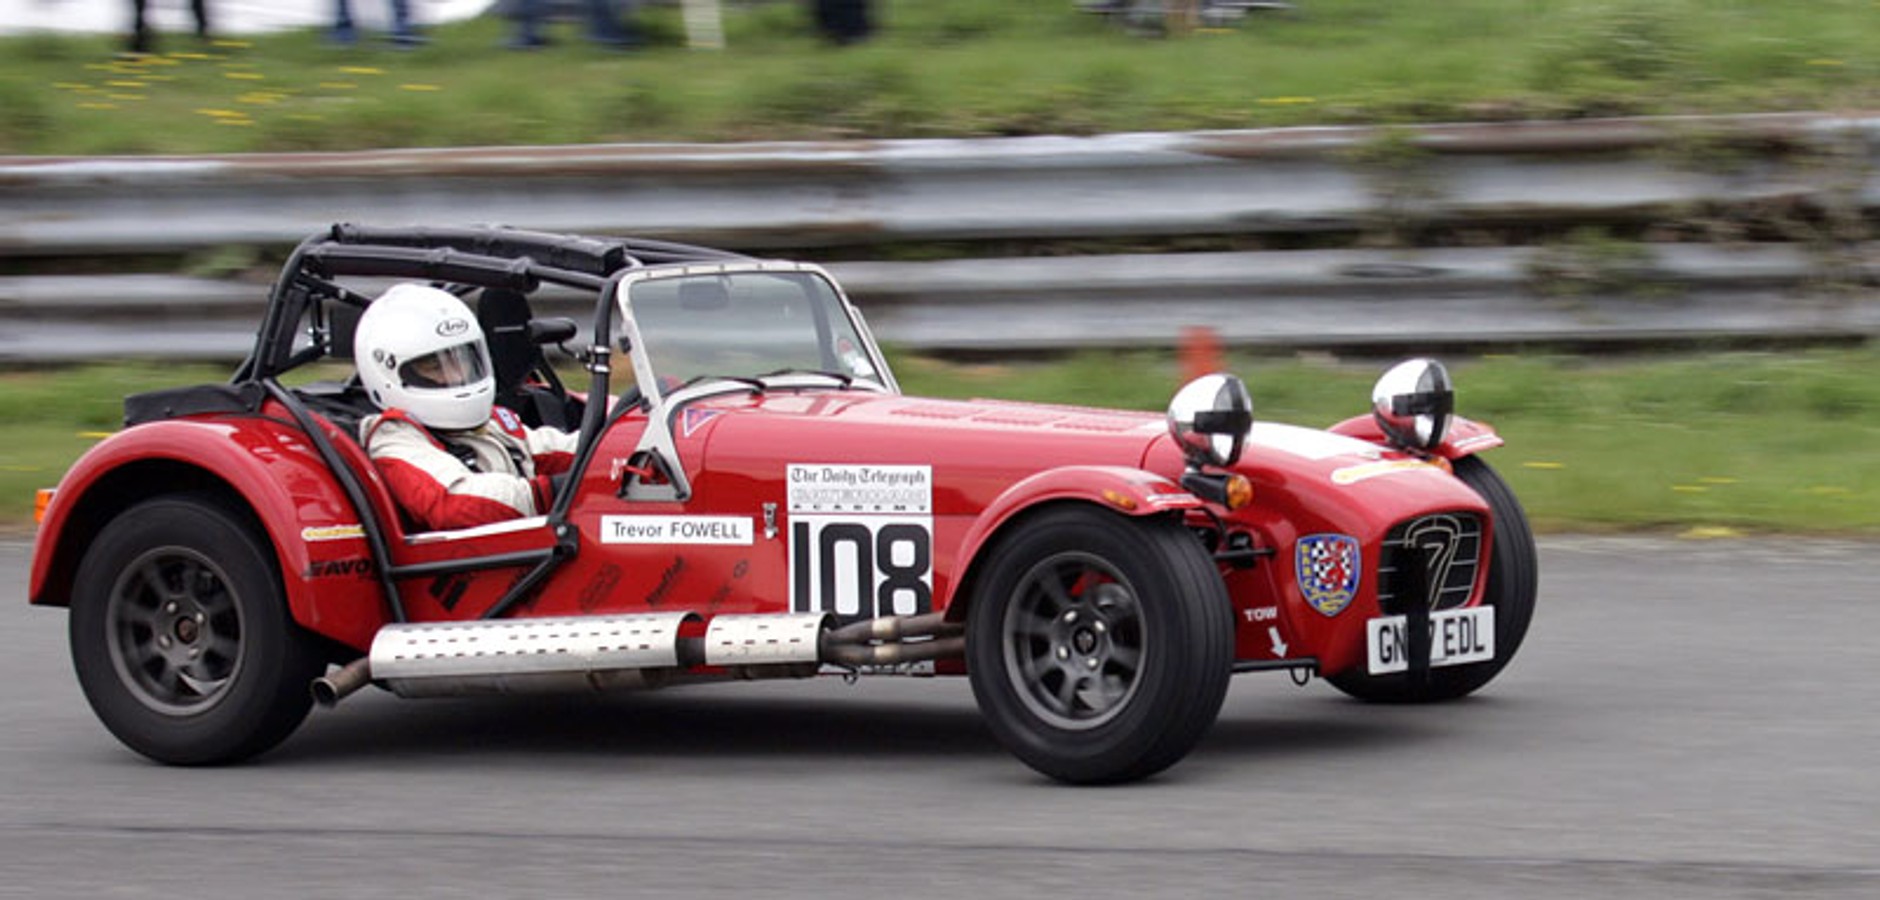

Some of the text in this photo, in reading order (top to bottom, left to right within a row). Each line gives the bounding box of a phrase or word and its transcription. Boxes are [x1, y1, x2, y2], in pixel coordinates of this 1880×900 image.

[791, 467, 925, 485] The Daily Telegraph
[613, 522, 741, 538] Trevor FOWELL
[793, 521, 932, 626] 108
[1243, 605, 1277, 621] TOW
[1379, 614, 1486, 664] GN7 EDL
